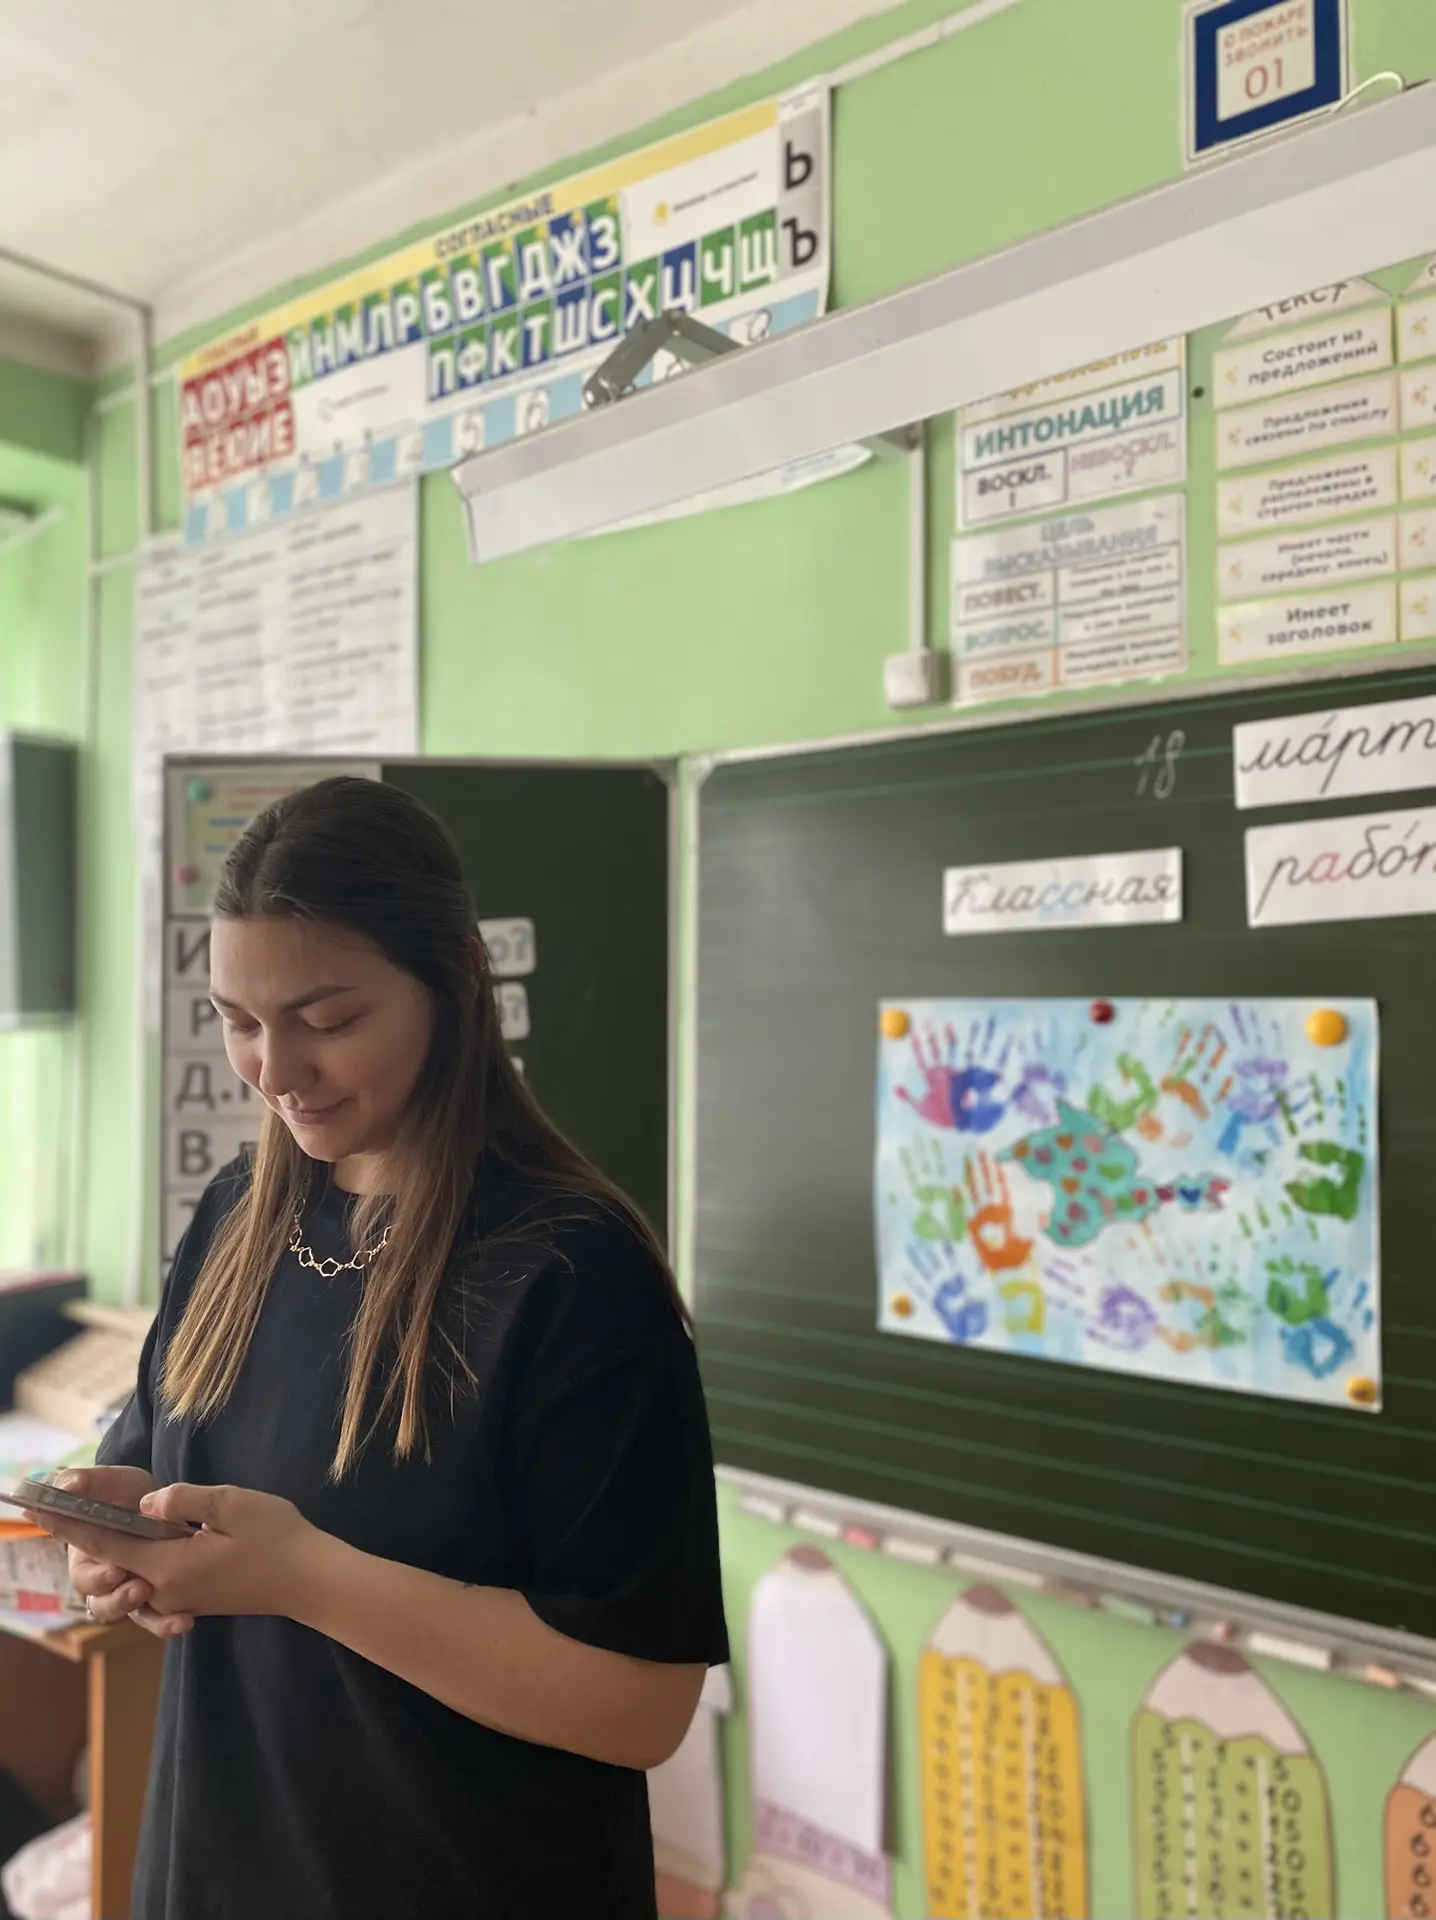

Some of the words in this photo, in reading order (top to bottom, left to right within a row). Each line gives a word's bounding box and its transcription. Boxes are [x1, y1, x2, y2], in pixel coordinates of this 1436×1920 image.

[1239, 5, 1307, 41] ПОЖАРЕ
[1223, 27, 1308, 67] ЗВОНИТЬ
[1244, 57, 1284, 99] 01
[434, 192, 555, 259] СОГЛАСНЫЕ
[1248, 340, 1379, 386] предложений
[1262, 334, 1339, 364] Состоит
[1343, 328, 1363, 343] из
[973, 385, 1165, 459] ИНТОНАЦИЯ
[976, 463, 1053, 497] ВОСКЛ.
[1286, 603, 1353, 625] Имеет
[1134, 729, 1185, 799] 18
